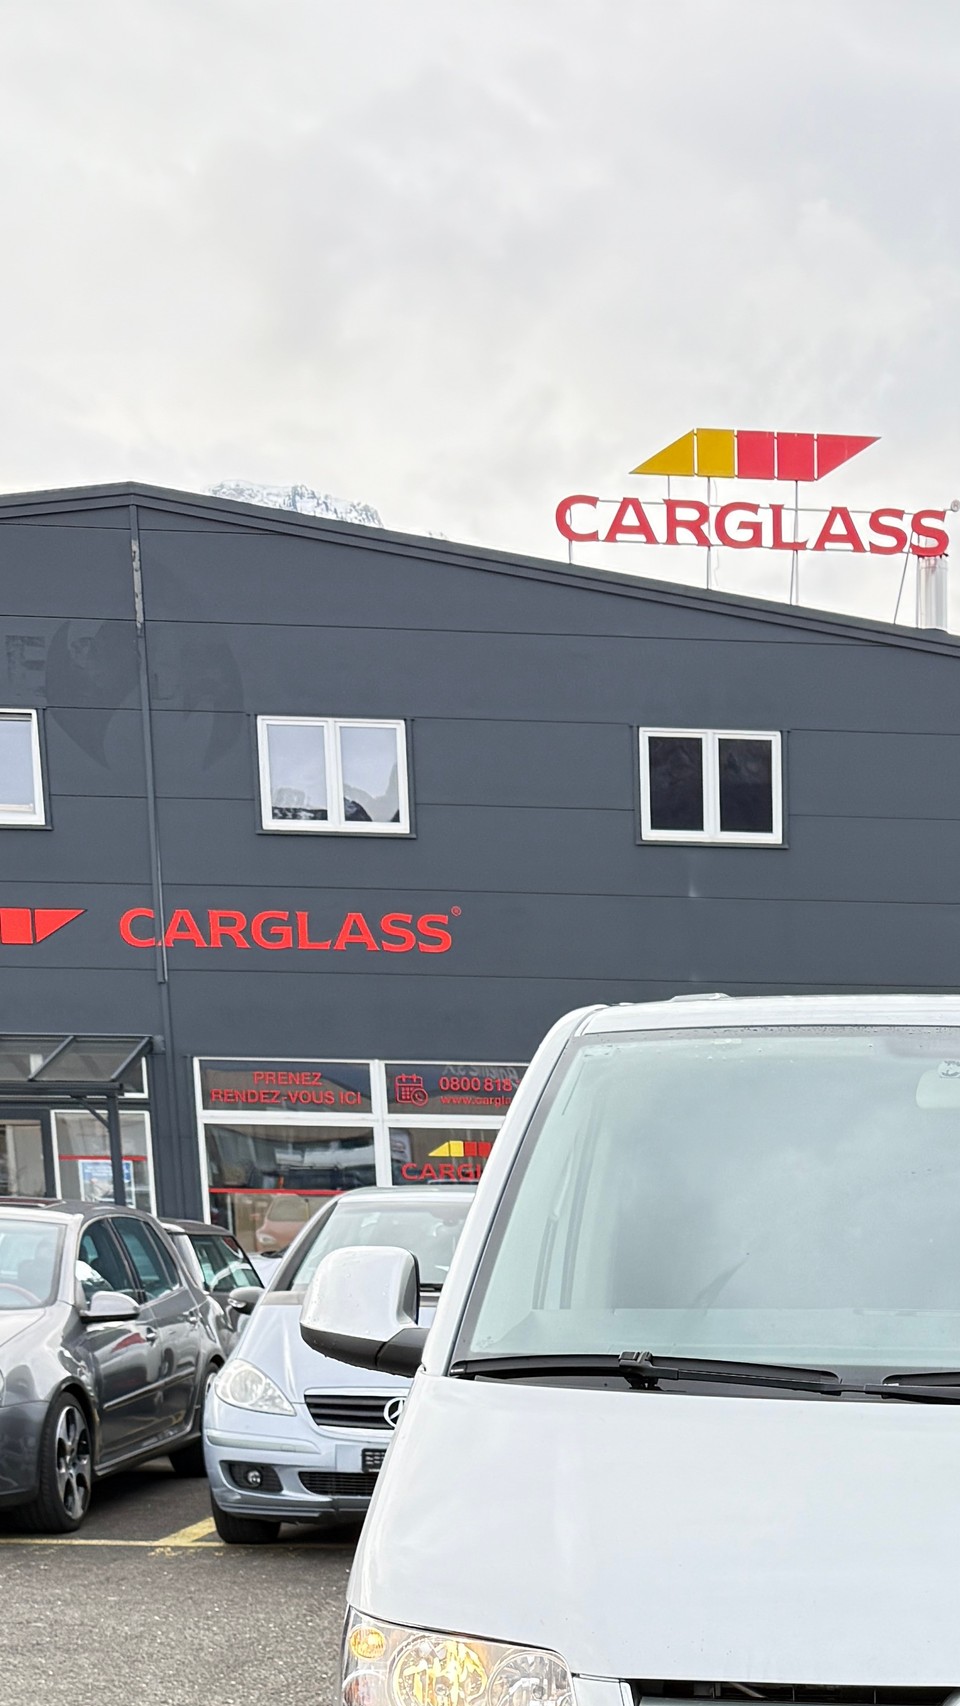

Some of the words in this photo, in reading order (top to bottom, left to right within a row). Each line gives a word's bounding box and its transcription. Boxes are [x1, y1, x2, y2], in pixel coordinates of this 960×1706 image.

[253, 1071, 323, 1087] PRENEZ
[439, 1076, 481, 1092] 0800
[484, 1077, 513, 1092] 818
[210, 1088, 335, 1105] RENDEZ-VOUS
[339, 1091, 362, 1105] ICI
